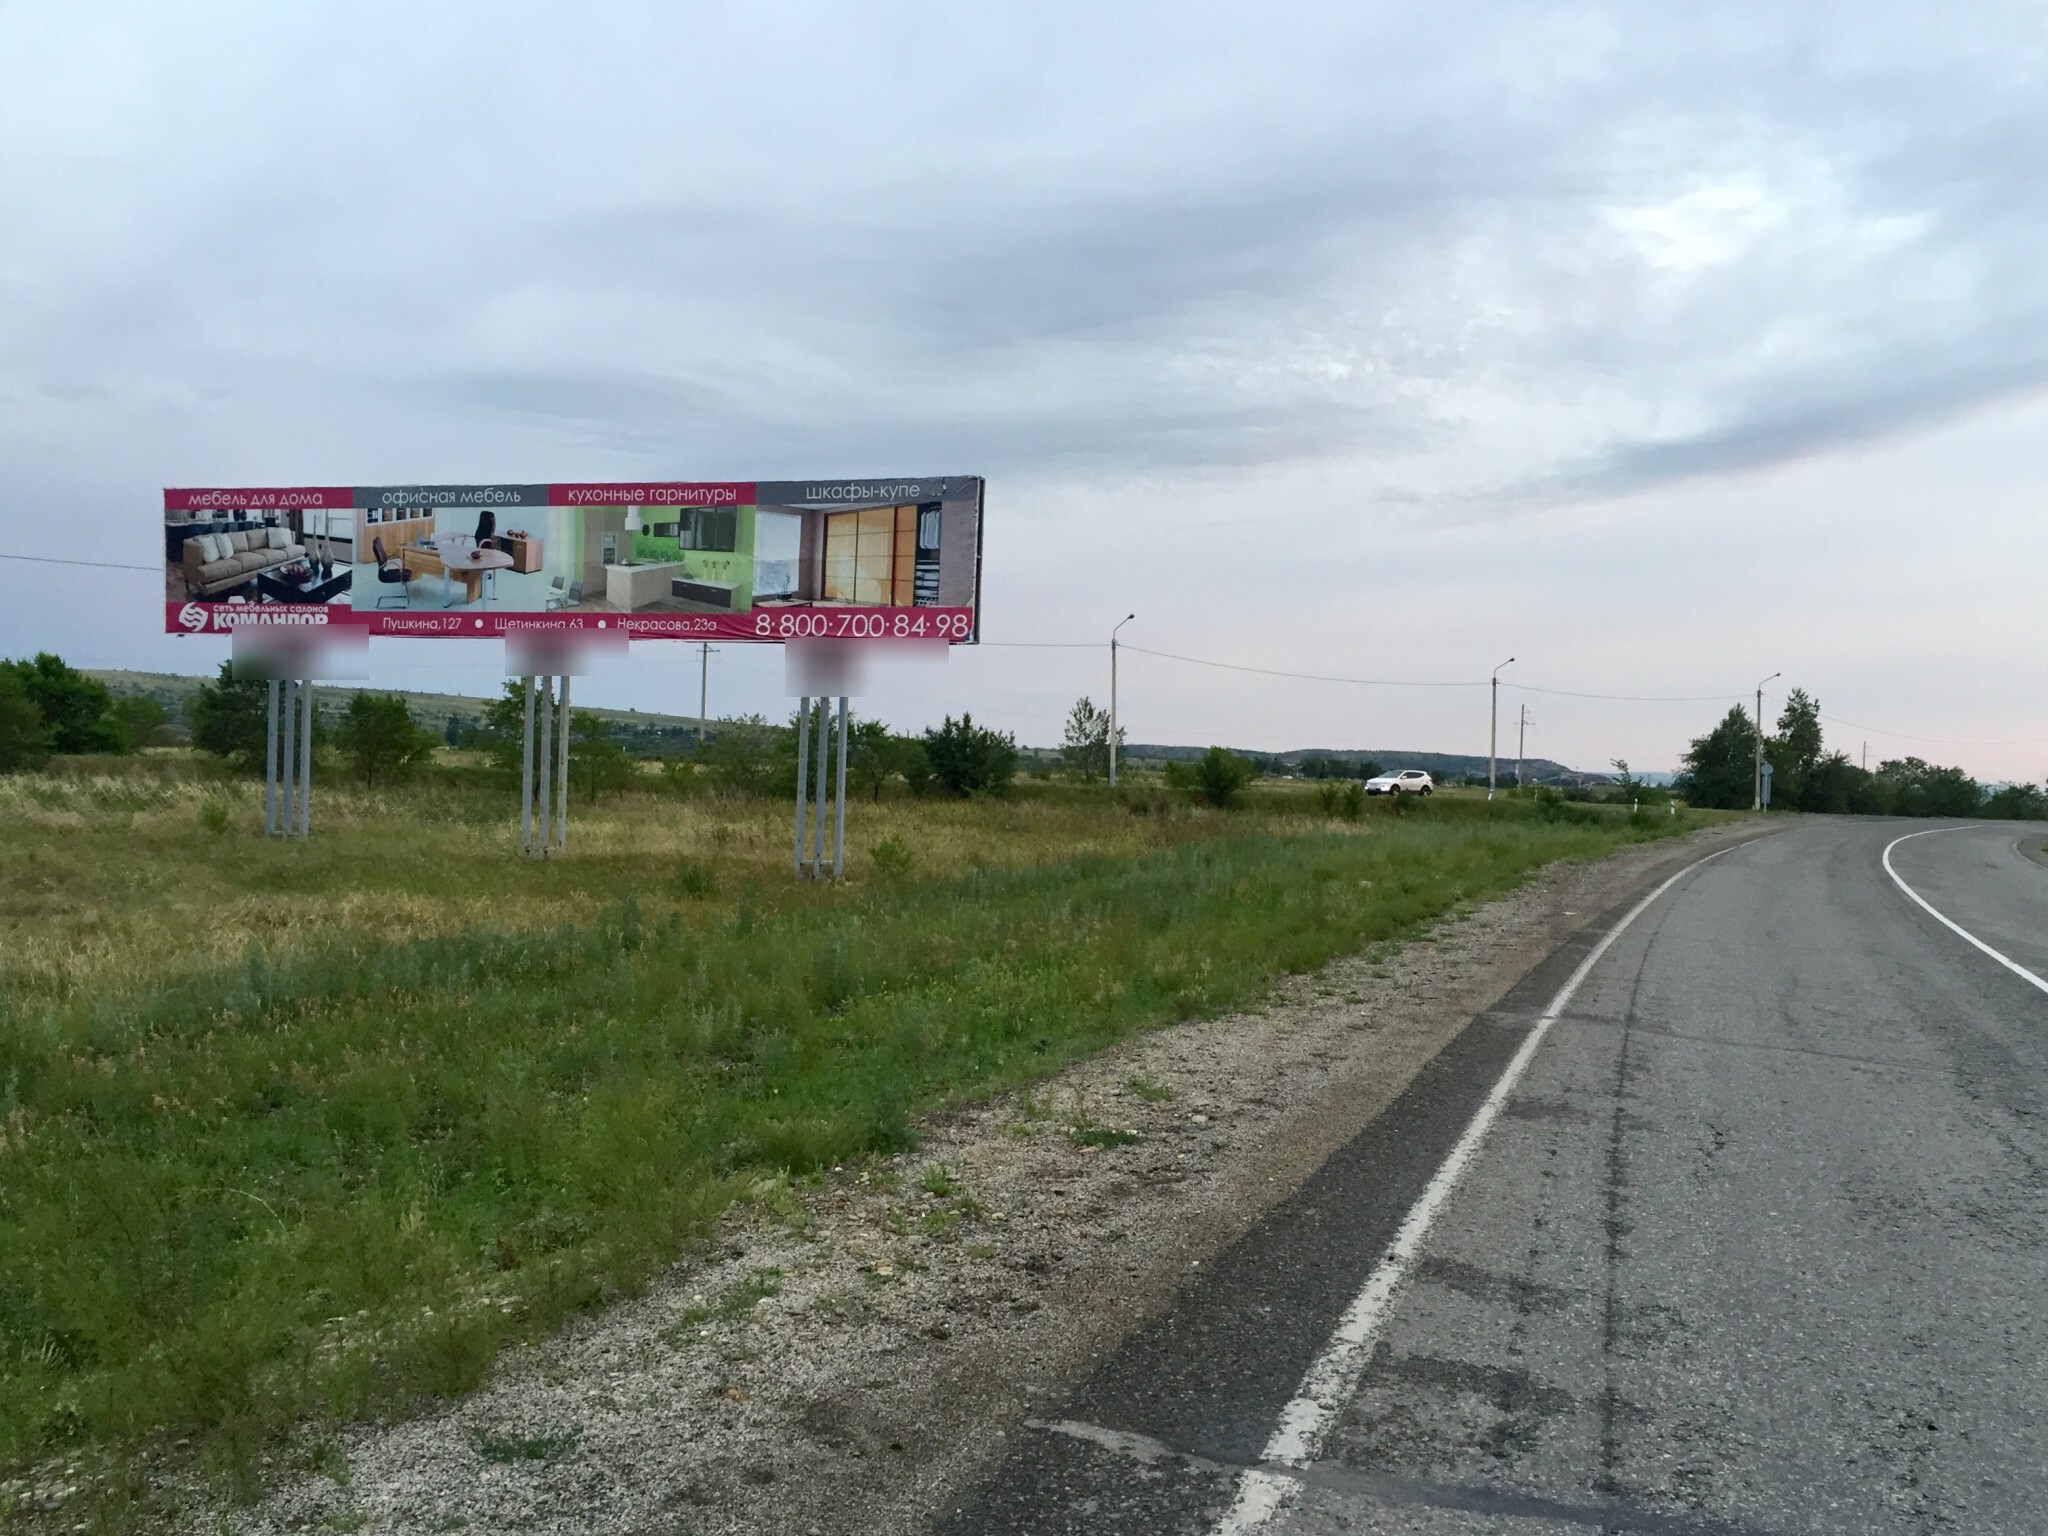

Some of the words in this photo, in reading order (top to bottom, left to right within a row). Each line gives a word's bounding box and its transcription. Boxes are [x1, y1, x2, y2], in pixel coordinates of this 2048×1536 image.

[188, 490, 247, 506] мебель
[250, 493, 276, 506] для
[279, 493, 323, 506] дома
[382, 488, 456, 507] офисная
[460, 488, 522, 503] мебель
[568, 488, 645, 504] кухонные
[649, 488, 737, 504] гарнитуры
[806, 483, 921, 502] шкафы-купе
[213, 605, 234, 613] сеть
[236, 603, 287, 613] мебельных
[290, 605, 329, 613] салонов
